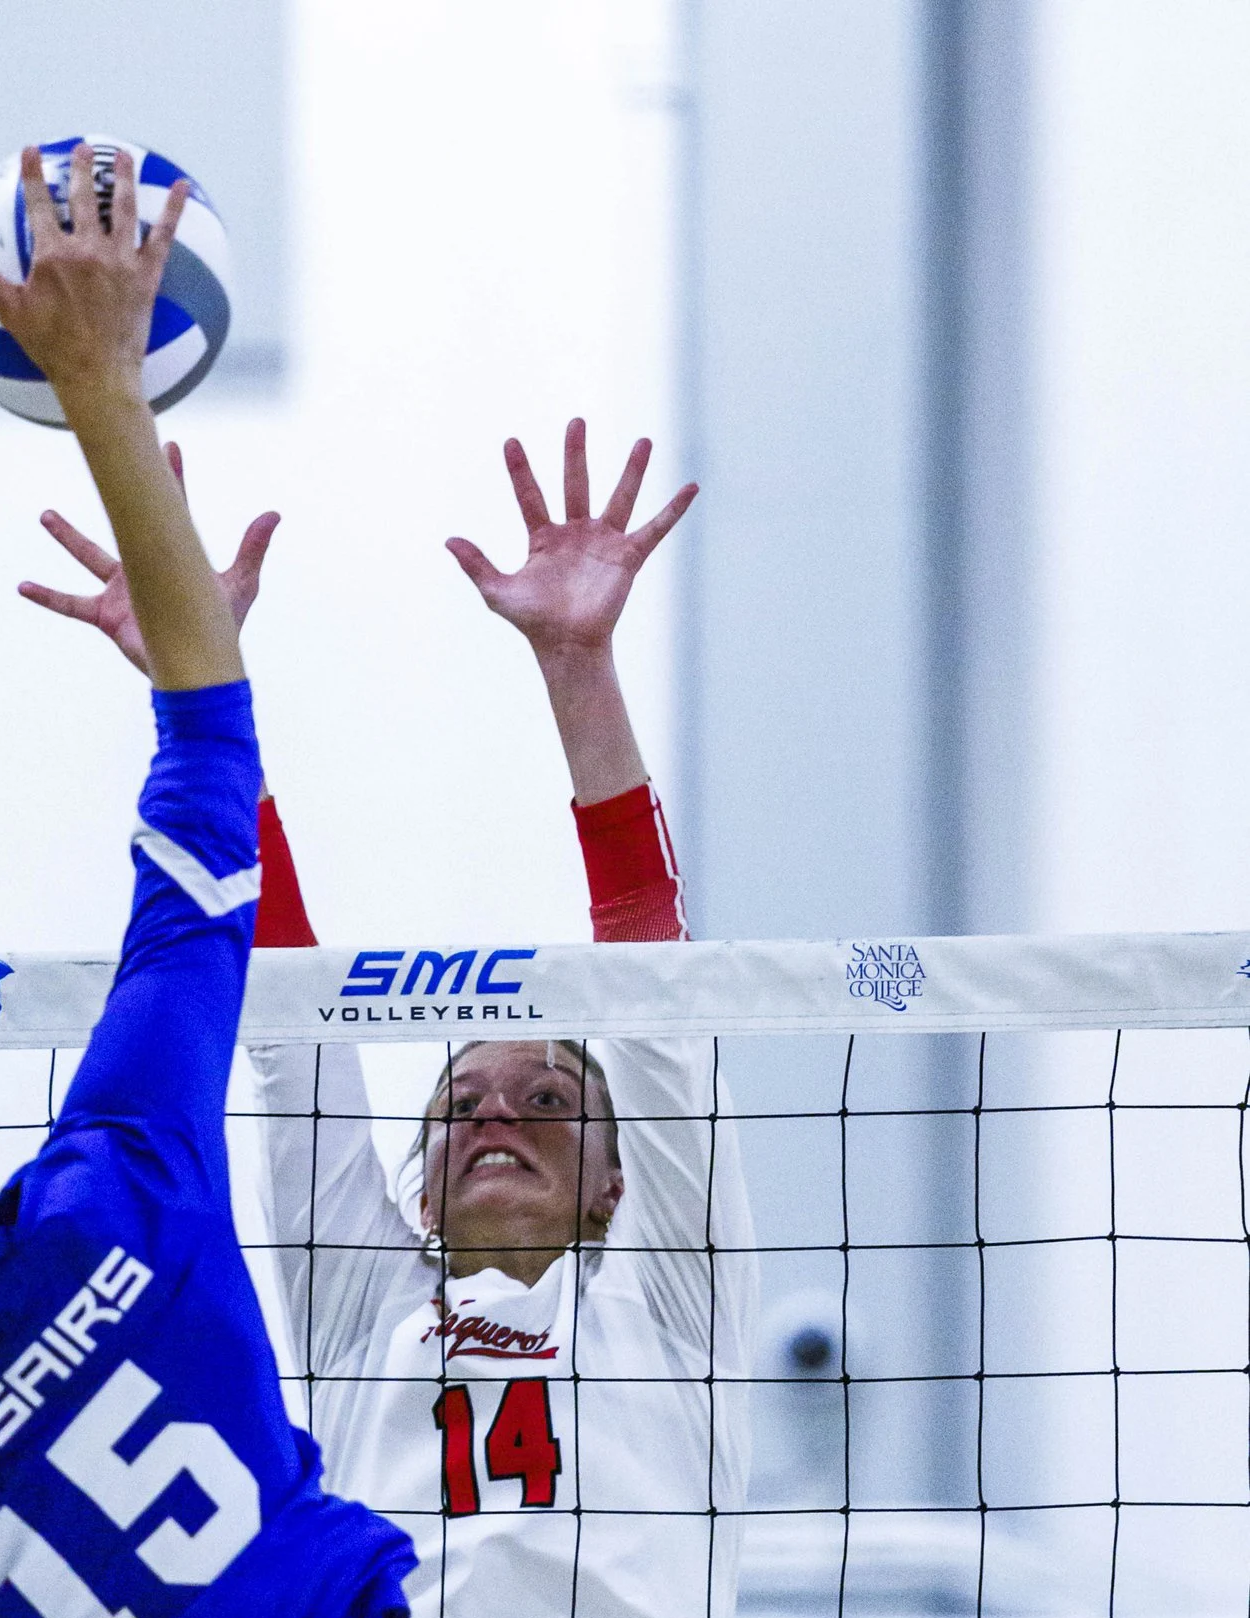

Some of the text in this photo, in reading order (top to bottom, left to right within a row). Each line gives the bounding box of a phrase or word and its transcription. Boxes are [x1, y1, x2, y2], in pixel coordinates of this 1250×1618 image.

[851, 943, 919, 962] SANTA
[340, 949, 537, 996] SMC
[846, 962, 927, 979] MONICA
[849, 979, 923, 1012] COLLEGE
[318, 1005, 543, 1021] VOLLEYBALL
[432, 1376, 562, 1519] 14
